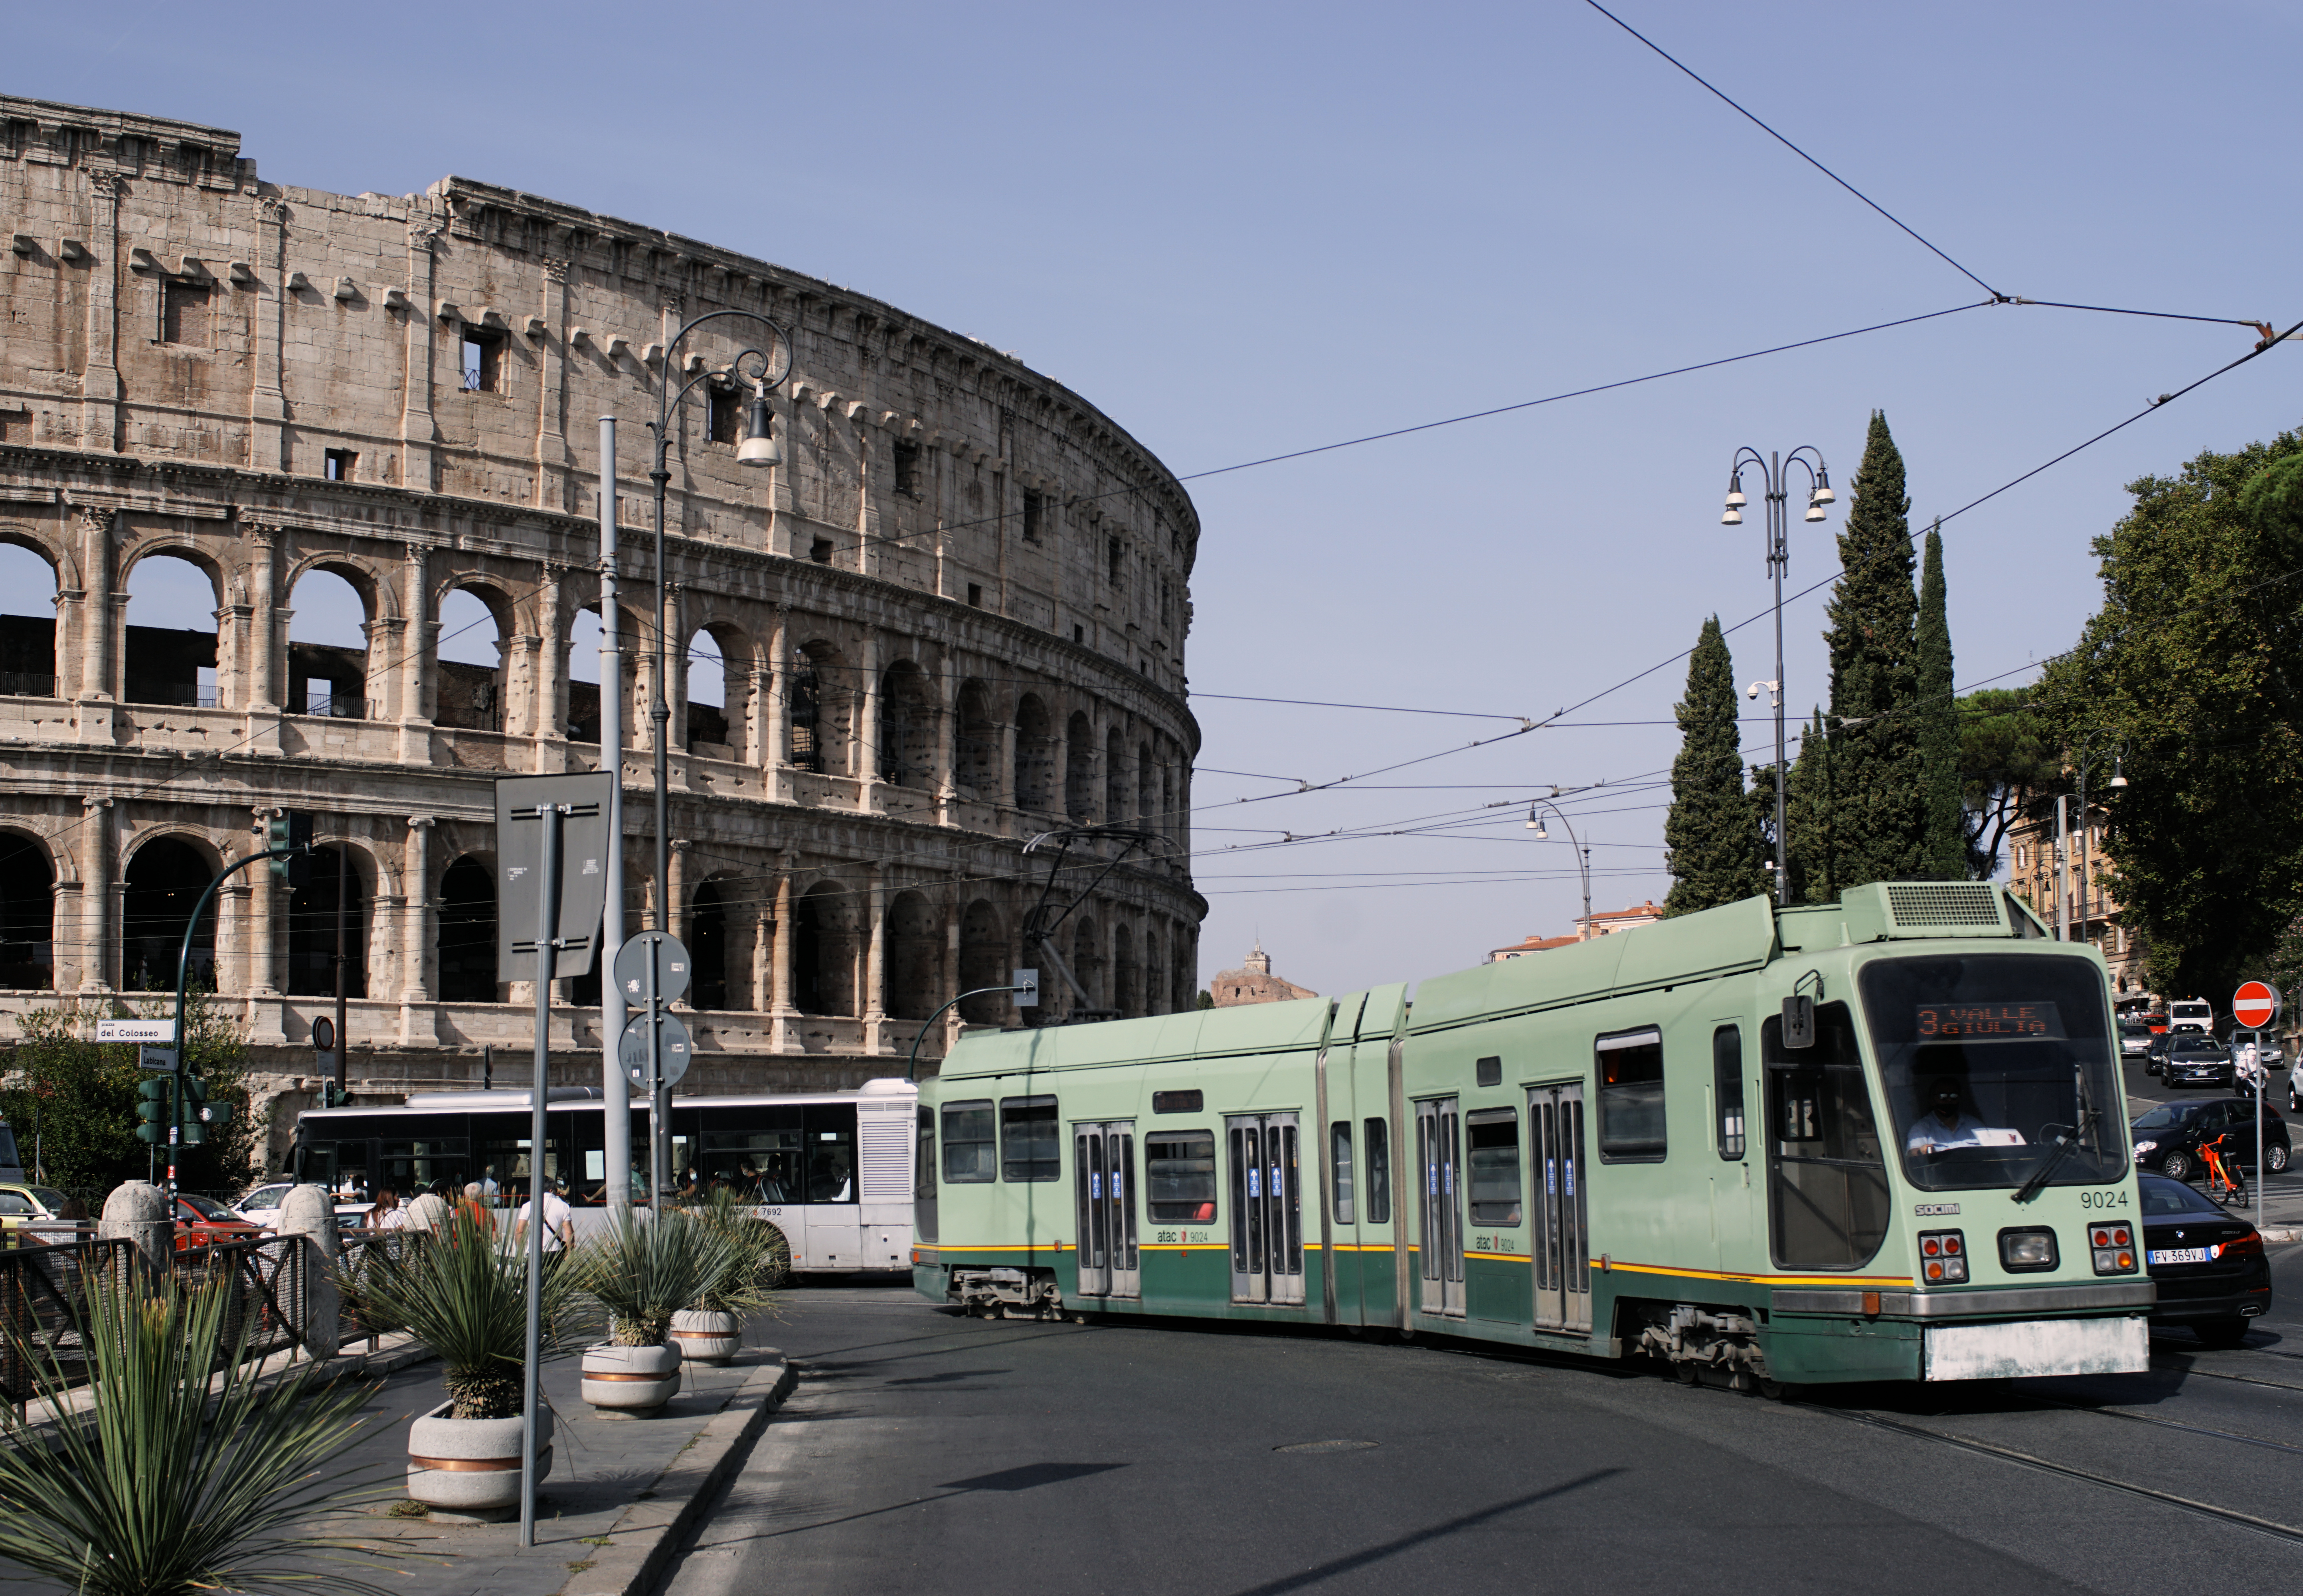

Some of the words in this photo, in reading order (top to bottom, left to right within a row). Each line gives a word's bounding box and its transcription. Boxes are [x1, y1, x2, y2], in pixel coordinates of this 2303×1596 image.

[1950, 1007, 2036, 1020] VALLE
[1918, 1010, 1937, 1034] 3
[1942, 1021, 2045, 1034] GIULIA
[144, 1056, 166, 1066] Labicana
[2081, 1191, 2129, 1209] 9024
[1158, 1230, 1177, 1242] atac
[1190, 1232, 1208, 1242] 9024
[1477, 1235, 1491, 1250] atac
[1501, 1238, 1514, 1251] 9024
